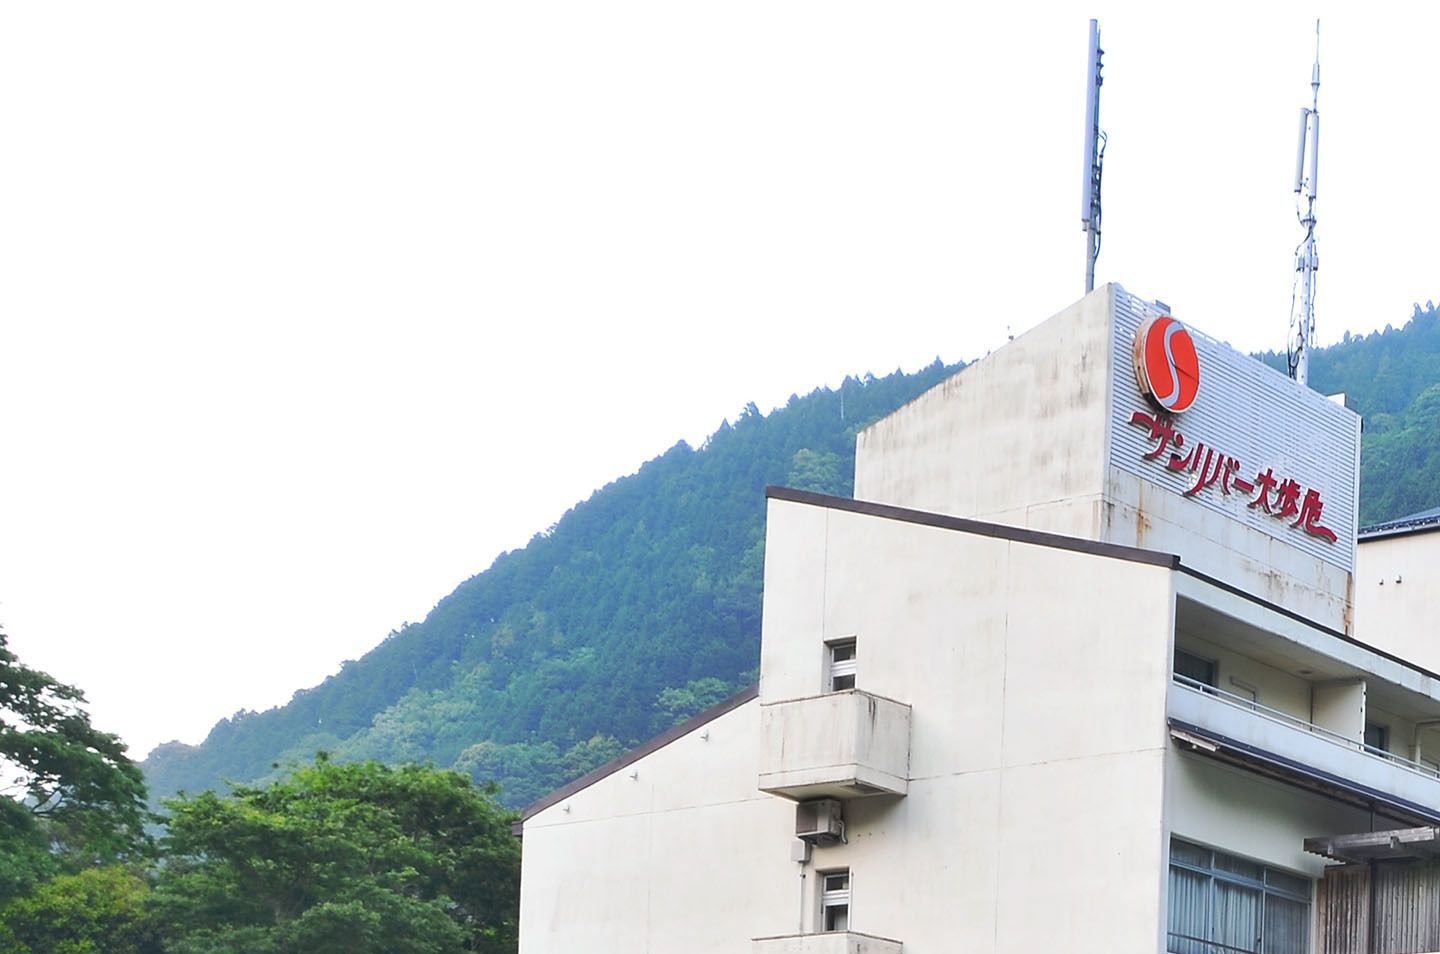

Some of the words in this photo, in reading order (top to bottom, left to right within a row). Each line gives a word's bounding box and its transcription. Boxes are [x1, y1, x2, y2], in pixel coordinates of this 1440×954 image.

[1128, 411, 1338, 543] サンリバー大歩危
